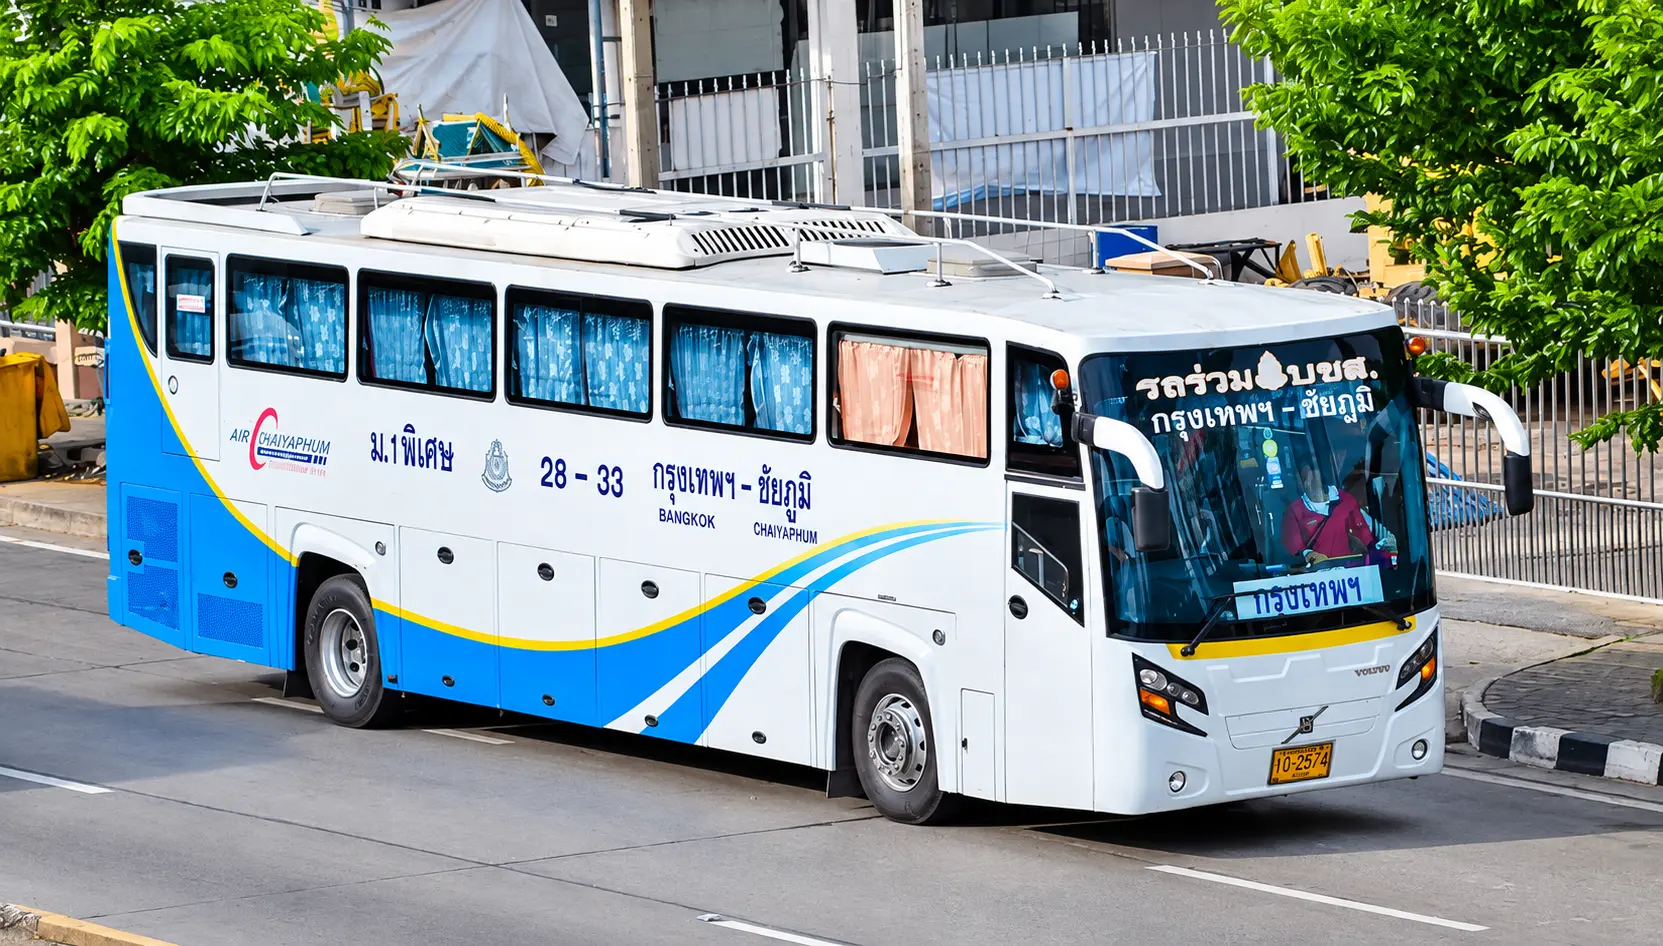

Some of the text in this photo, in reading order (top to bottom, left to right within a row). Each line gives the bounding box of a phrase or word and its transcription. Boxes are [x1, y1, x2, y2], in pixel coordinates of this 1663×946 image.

[1135, 356, 1379, 400] รถร่วม บขส.
[1151, 400, 1275, 442] กรุงเทพฯ
[1301, 385, 1375, 424] ชัยภูมิ
[229, 428, 251, 443] AIR
[258, 431, 331, 455] CHAIYAPHUM
[540, 456, 567, 489] 28
[596, 464, 624, 498] 33
[652, 462, 735, 505] กรุงเทพฯ
[757, 463, 812, 523] ชัยภูมิ
[658, 508, 818, 545] BANGKOK CHAIYAPHUM
[1275, 751, 1329, 774] 10-2574
